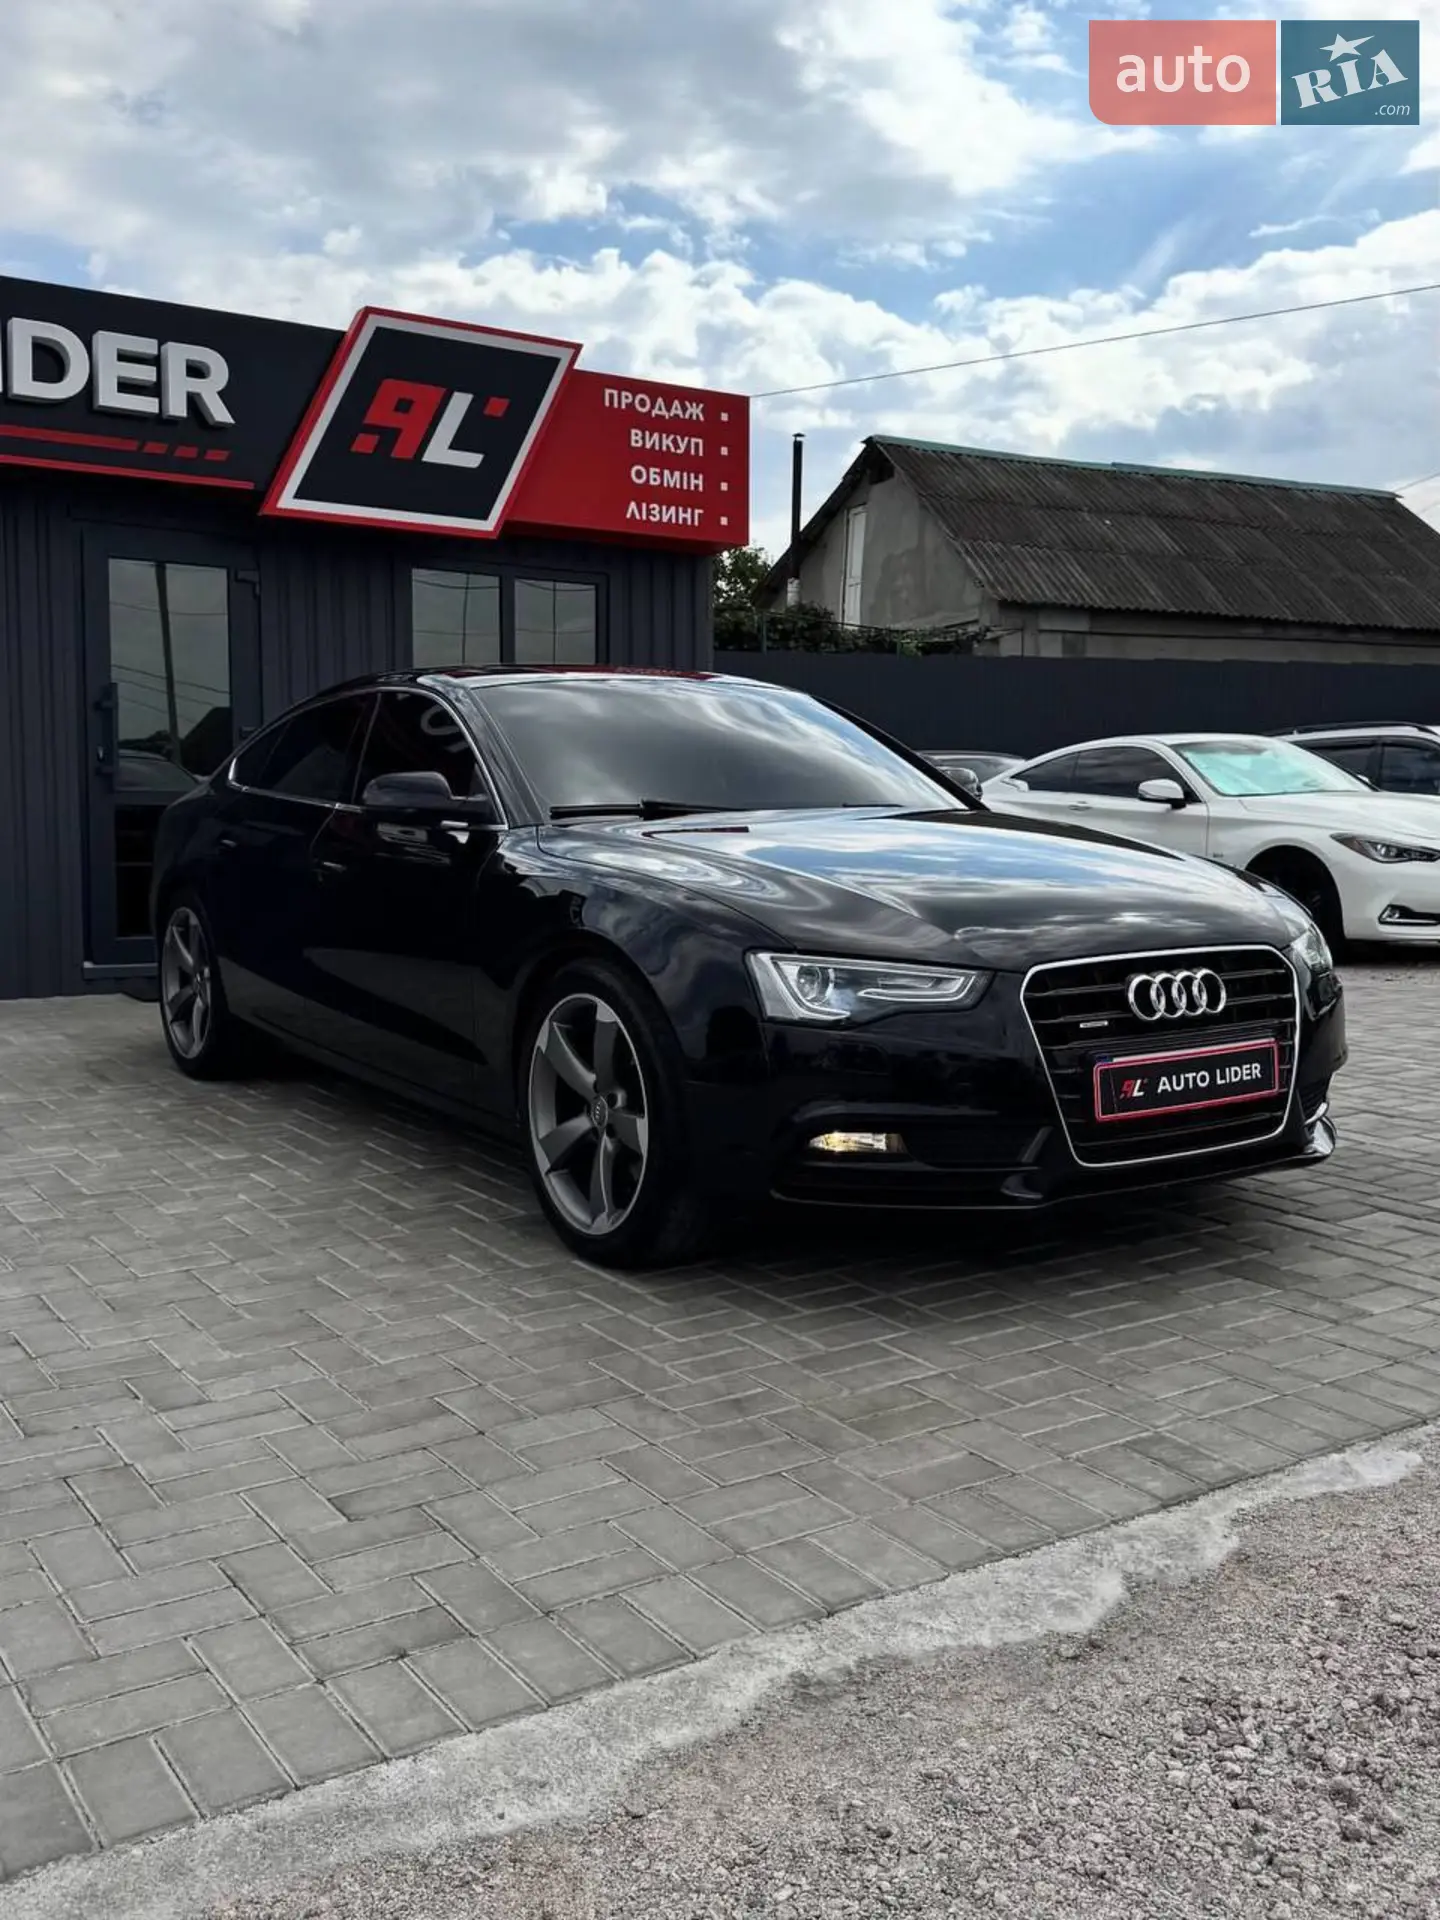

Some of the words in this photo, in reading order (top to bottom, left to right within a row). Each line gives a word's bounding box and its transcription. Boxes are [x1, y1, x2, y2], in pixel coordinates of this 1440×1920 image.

[0, 316, 235, 427] DER
[603, 387, 705, 422] ПРОДАЖ
[630, 428, 704, 457] ВИКУП
[630, 464, 704, 493] ОБМІН
[625, 500, 704, 527] ЛІЗИНГ
[1157, 1070, 1210, 1094] AUTO
[1215, 1062, 1262, 1085] LIDER
